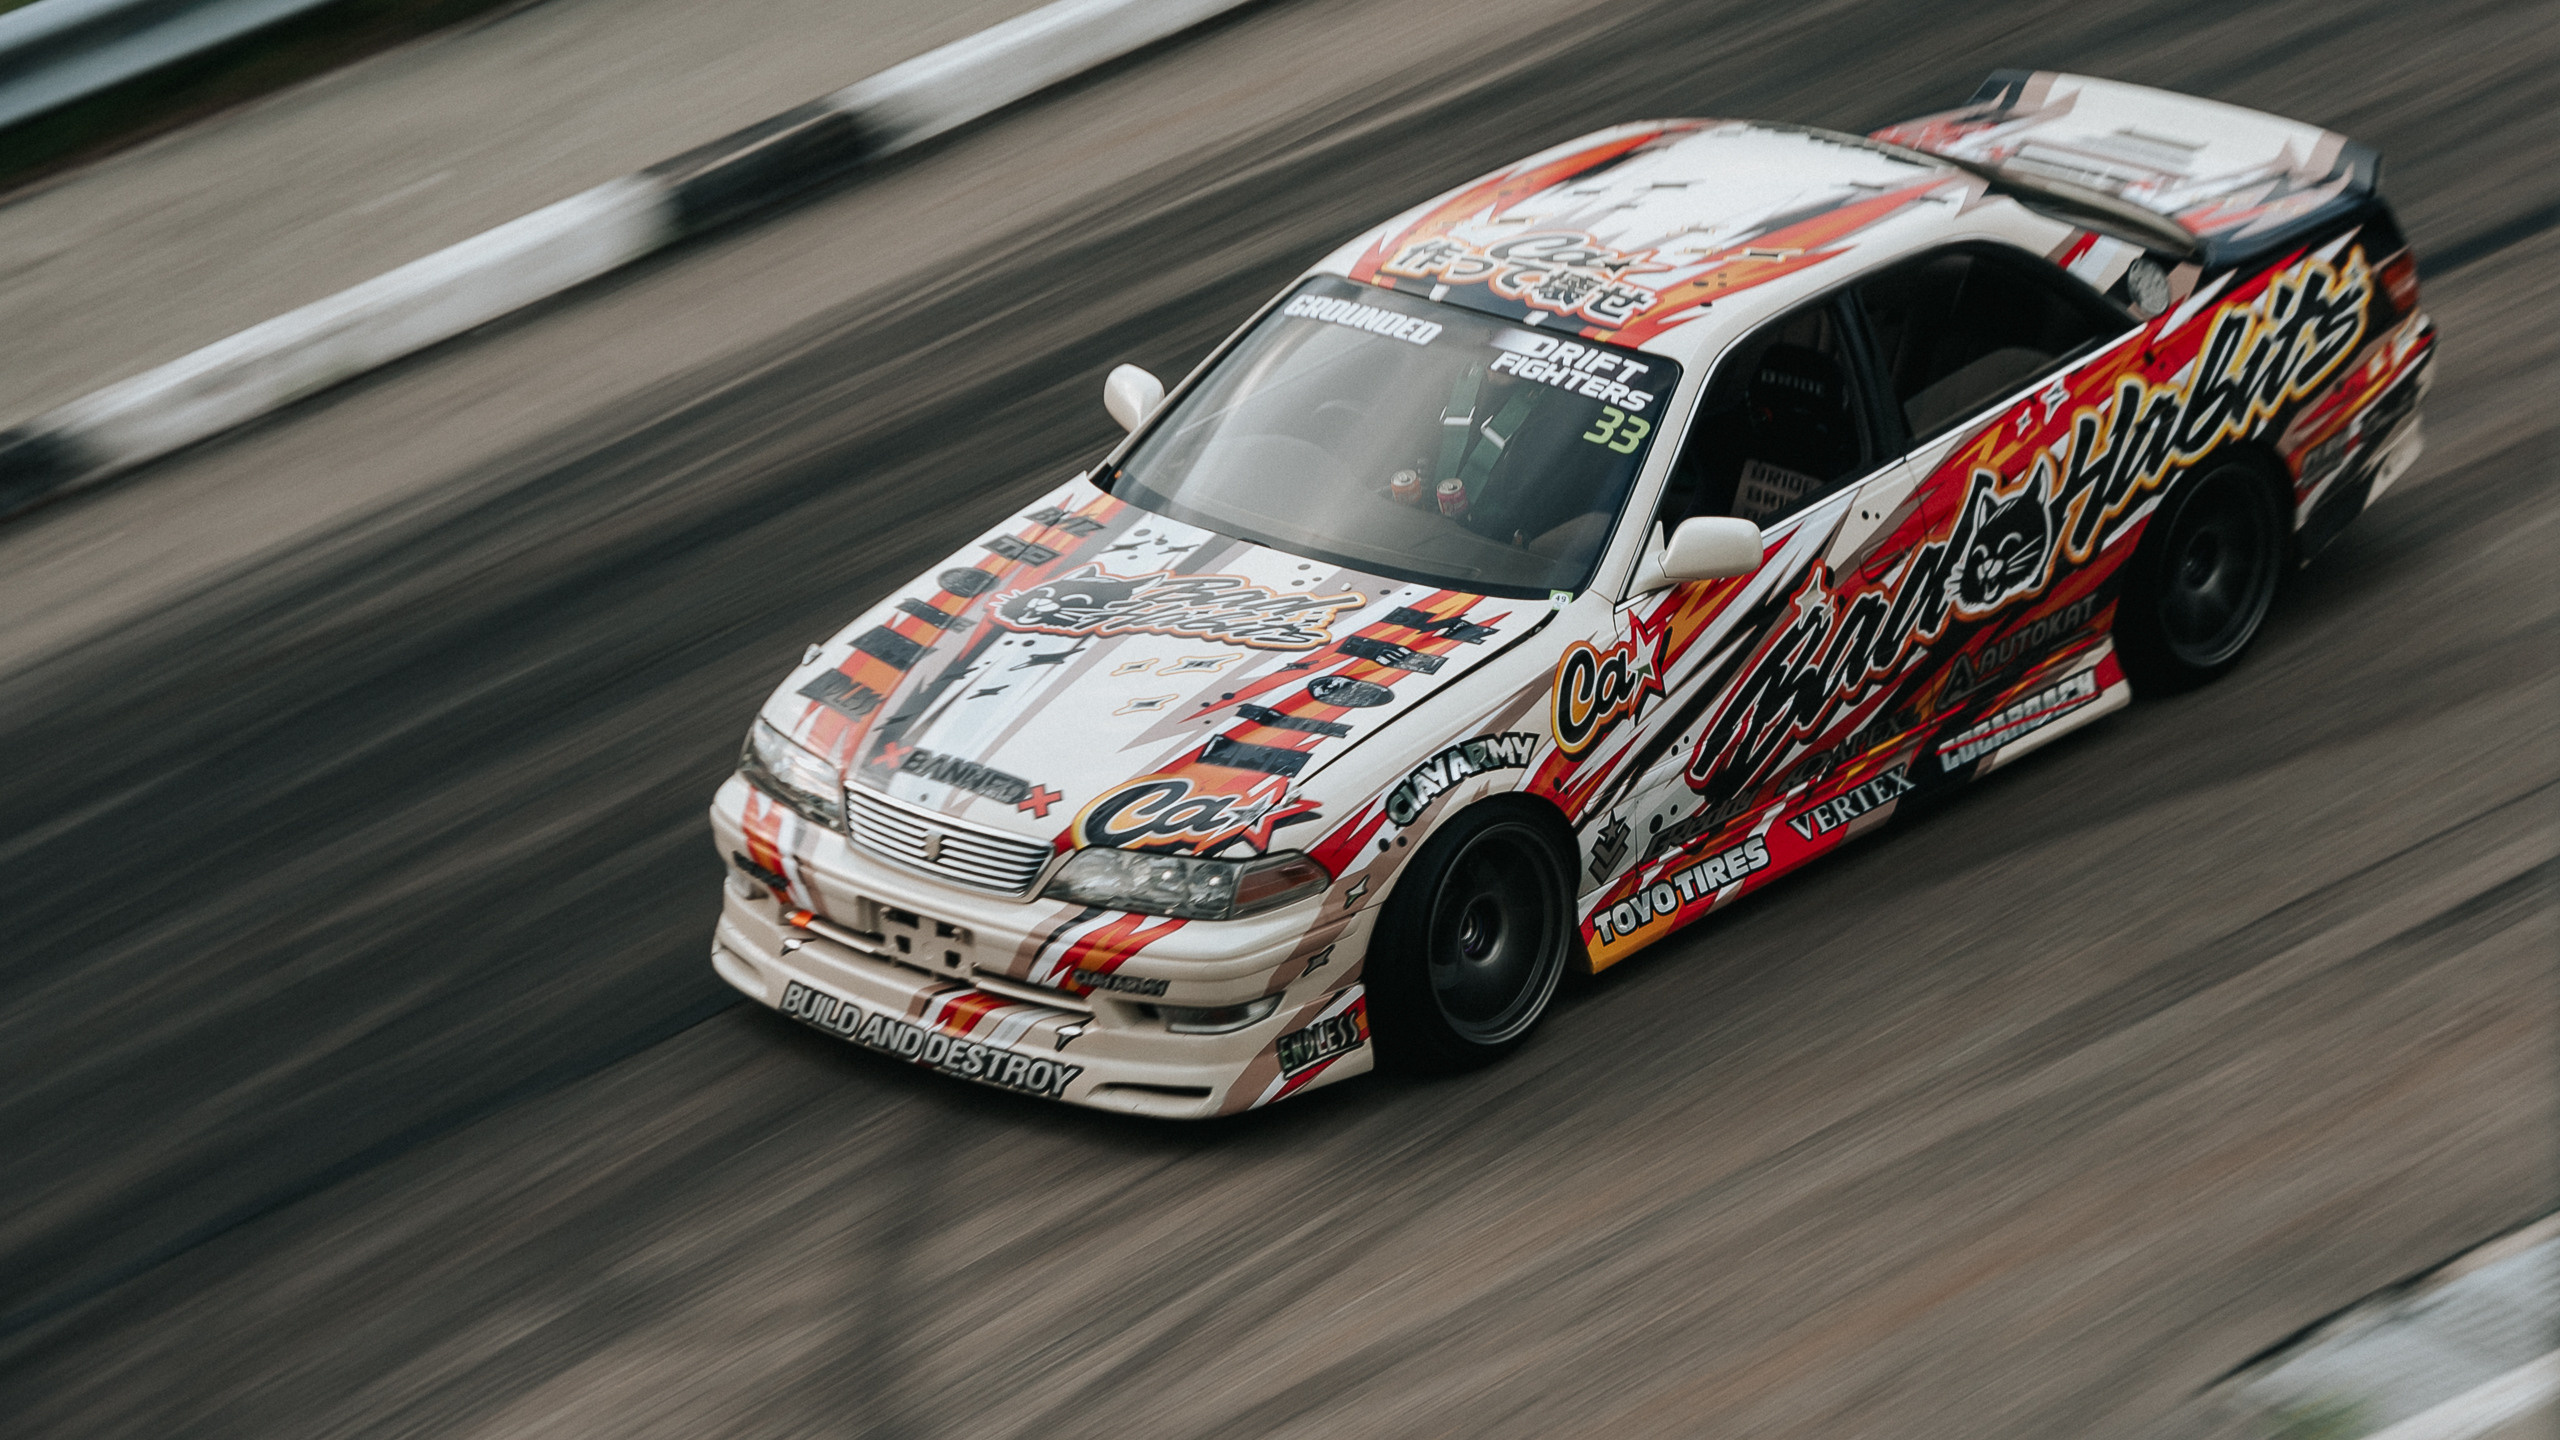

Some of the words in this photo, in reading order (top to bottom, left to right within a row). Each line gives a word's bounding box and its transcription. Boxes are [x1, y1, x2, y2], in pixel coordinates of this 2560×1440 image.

[1283, 295, 1443, 345] GROUNDED
[1531, 332, 1648, 384] DRIFT
[1490, 350, 1653, 411] FIGHTERS
[2050, 258, 2366, 556] Habits
[1582, 405, 1650, 453] 33
[1690, 470, 1996, 800] Bad
[1978, 593, 2098, 675] AUTOKAT
[1788, 766, 1917, 842] VERTEX
[1594, 882, 1677, 946] TOYO
[1675, 836, 1771, 903] TIRES
[781, 981, 861, 1037] BUILD
[858, 1014, 925, 1057] AND
[924, 1033, 1084, 1098] DESTROY
